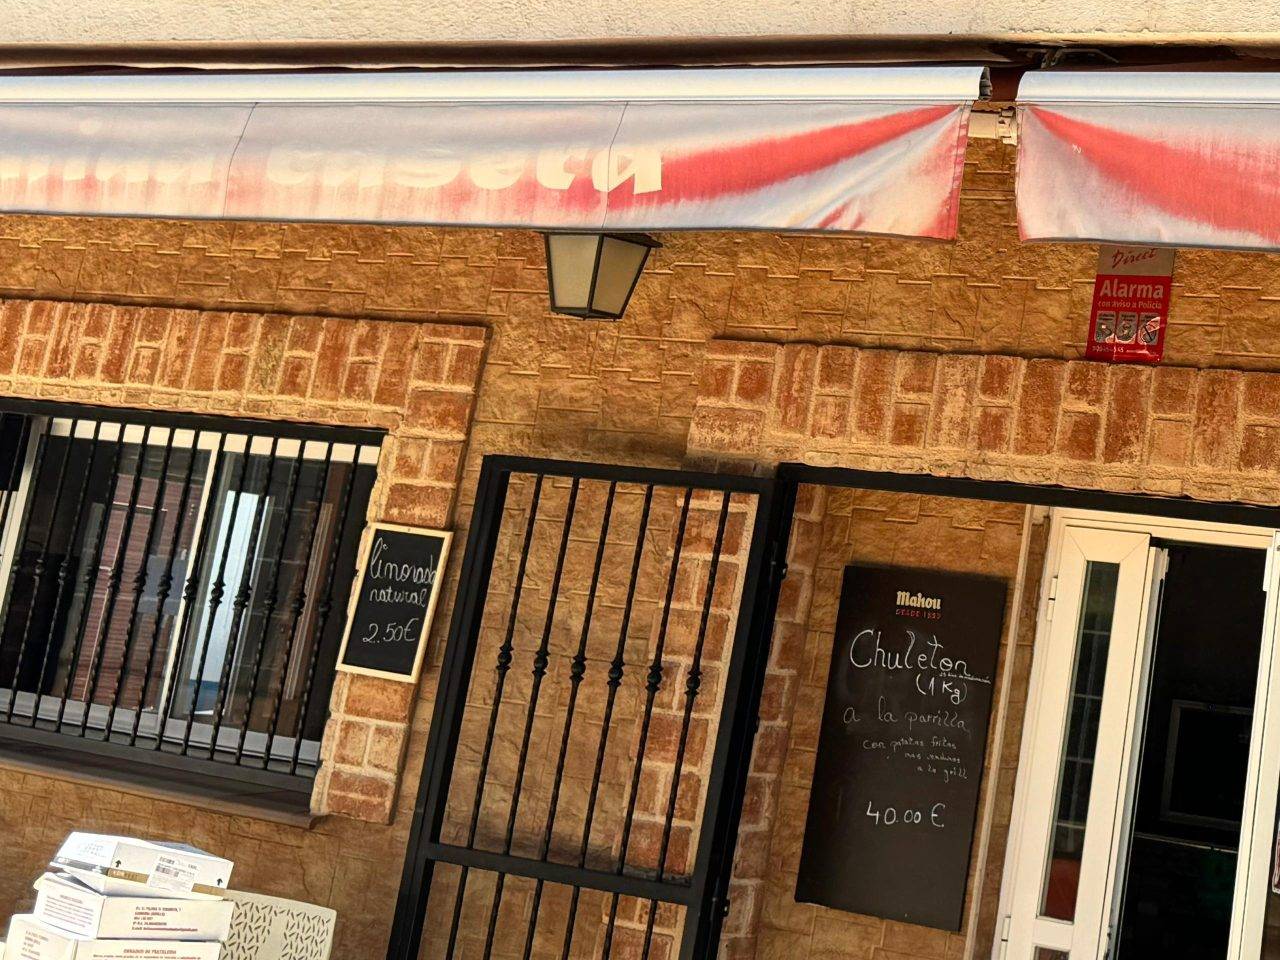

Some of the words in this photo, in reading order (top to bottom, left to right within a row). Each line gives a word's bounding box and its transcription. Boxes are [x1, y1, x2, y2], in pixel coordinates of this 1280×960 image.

[1100, 278, 1164, 299] Alarma
[1111, 299, 1131, 308] aviso
[369, 586, 428, 608] natural
[896, 590, 942, 610] Mahou
[878, 695, 898, 722] la
[866, 801, 922, 825] 40.00
